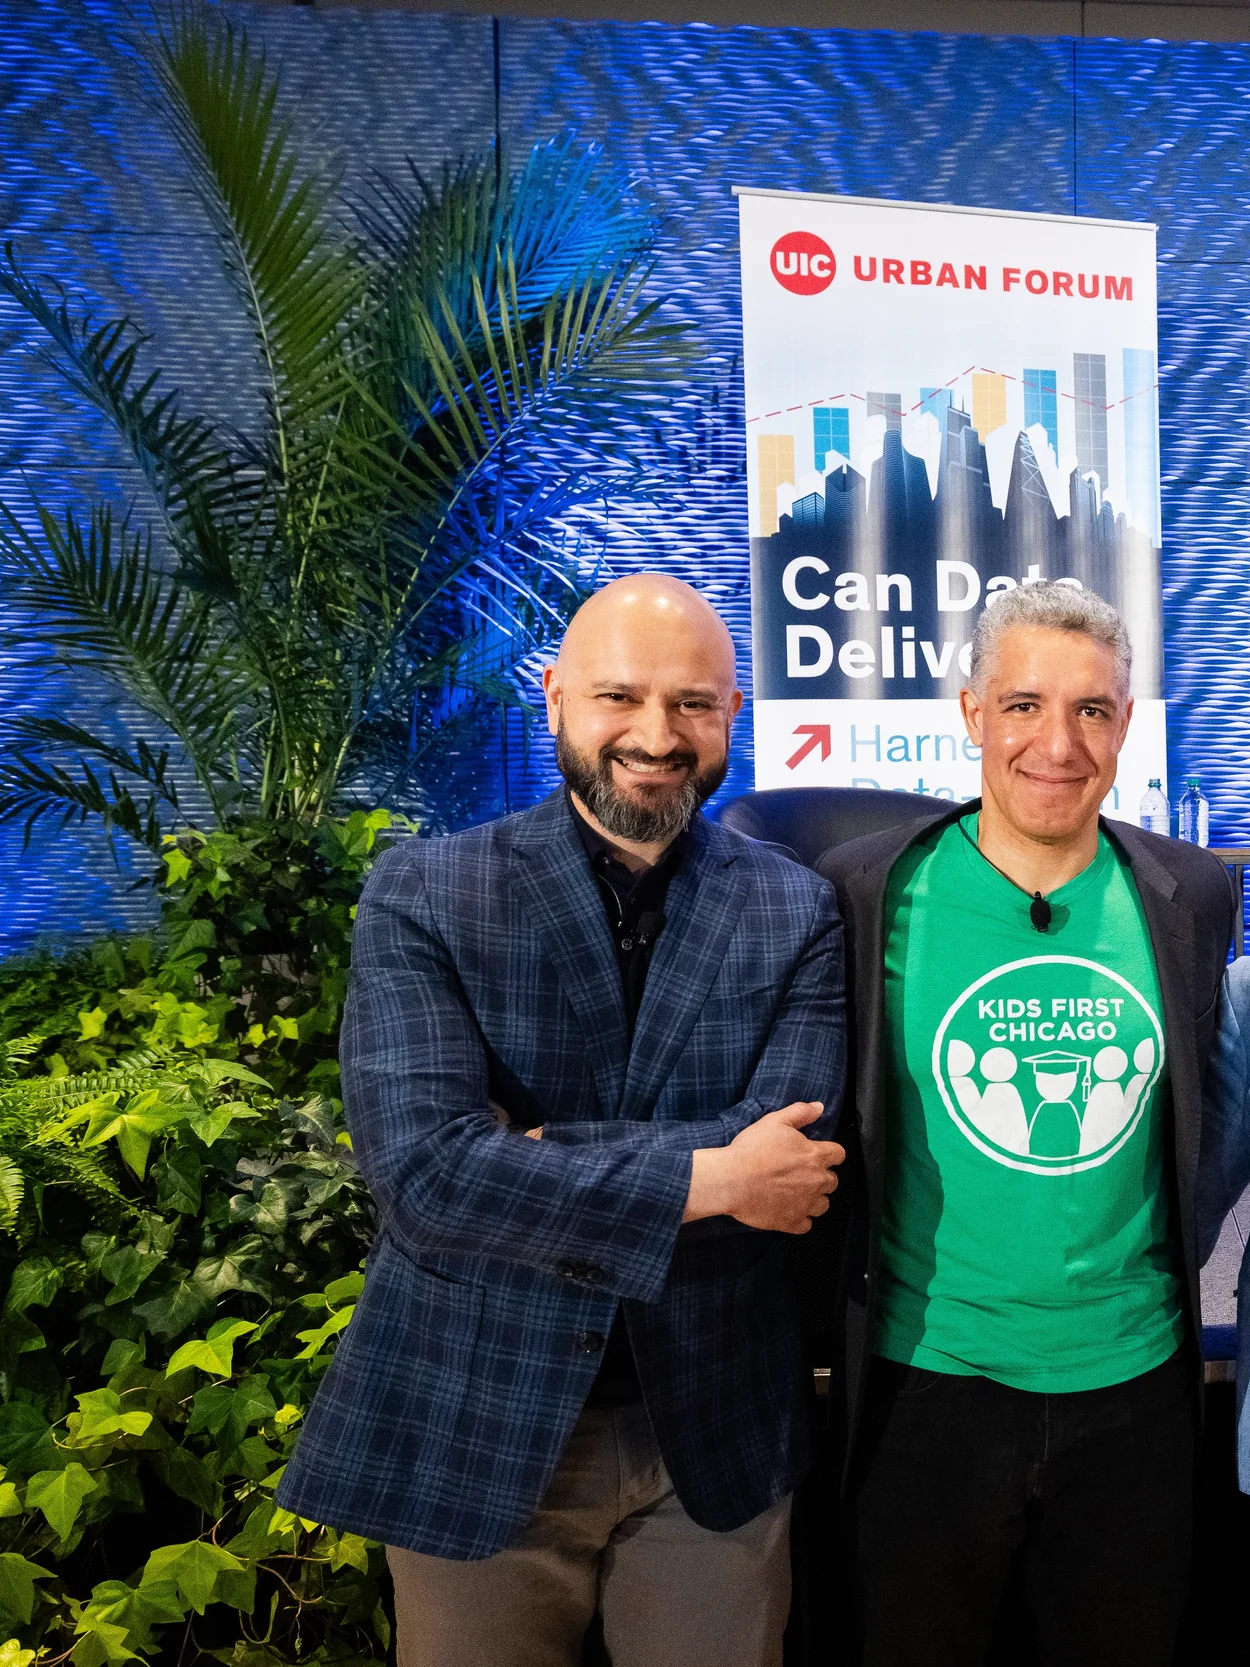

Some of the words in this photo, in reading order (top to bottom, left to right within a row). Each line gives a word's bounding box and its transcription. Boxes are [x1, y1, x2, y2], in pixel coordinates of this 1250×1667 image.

[775, 250, 832, 279] UIC
[853, 254, 987, 290] URBAN
[1002, 267, 1134, 301] FORUM
[782, 555, 913, 613] Can
[935, 559, 1083, 612] Da
[977, 998, 1042, 1020] KIDS
[1051, 997, 1125, 1018] FIRST
[988, 1021, 1117, 1042] CHICAGO
